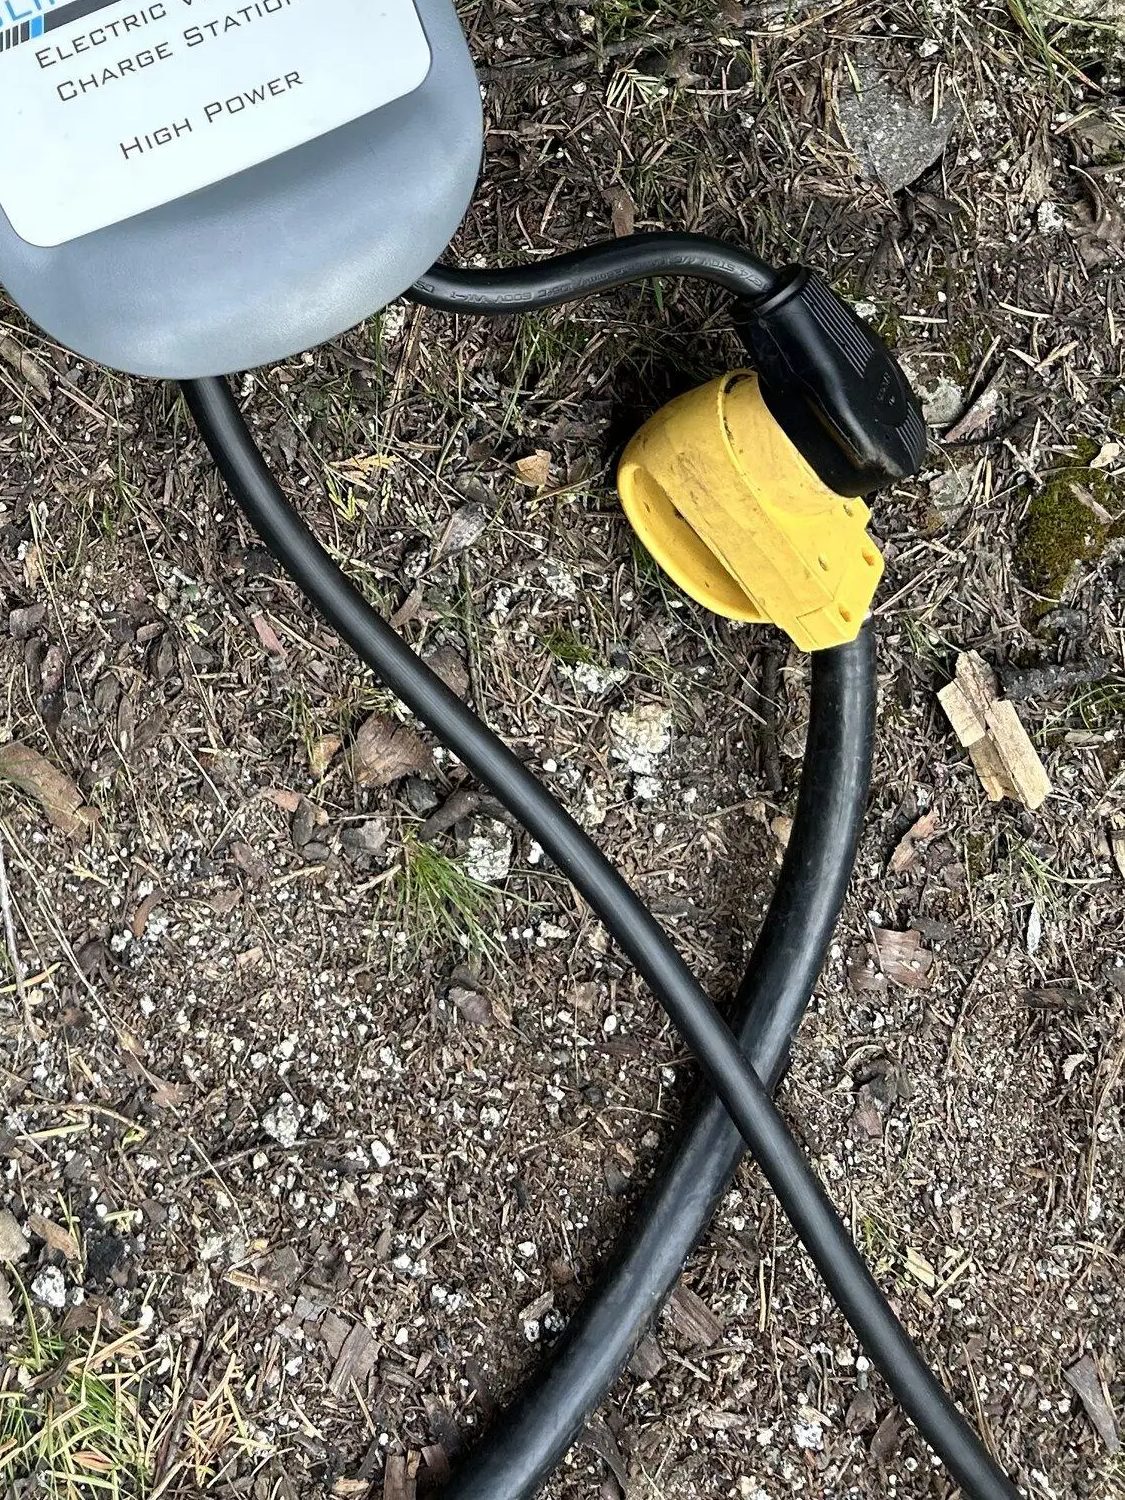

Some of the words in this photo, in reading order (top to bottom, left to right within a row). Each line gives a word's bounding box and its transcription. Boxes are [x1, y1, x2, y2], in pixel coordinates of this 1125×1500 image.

[34, 2, 167, 69] ELECTRIC
[56, 41, 174, 102] CHARGE
[119, 118, 193, 160] HIGH
[203, 71, 303, 124] POWER
